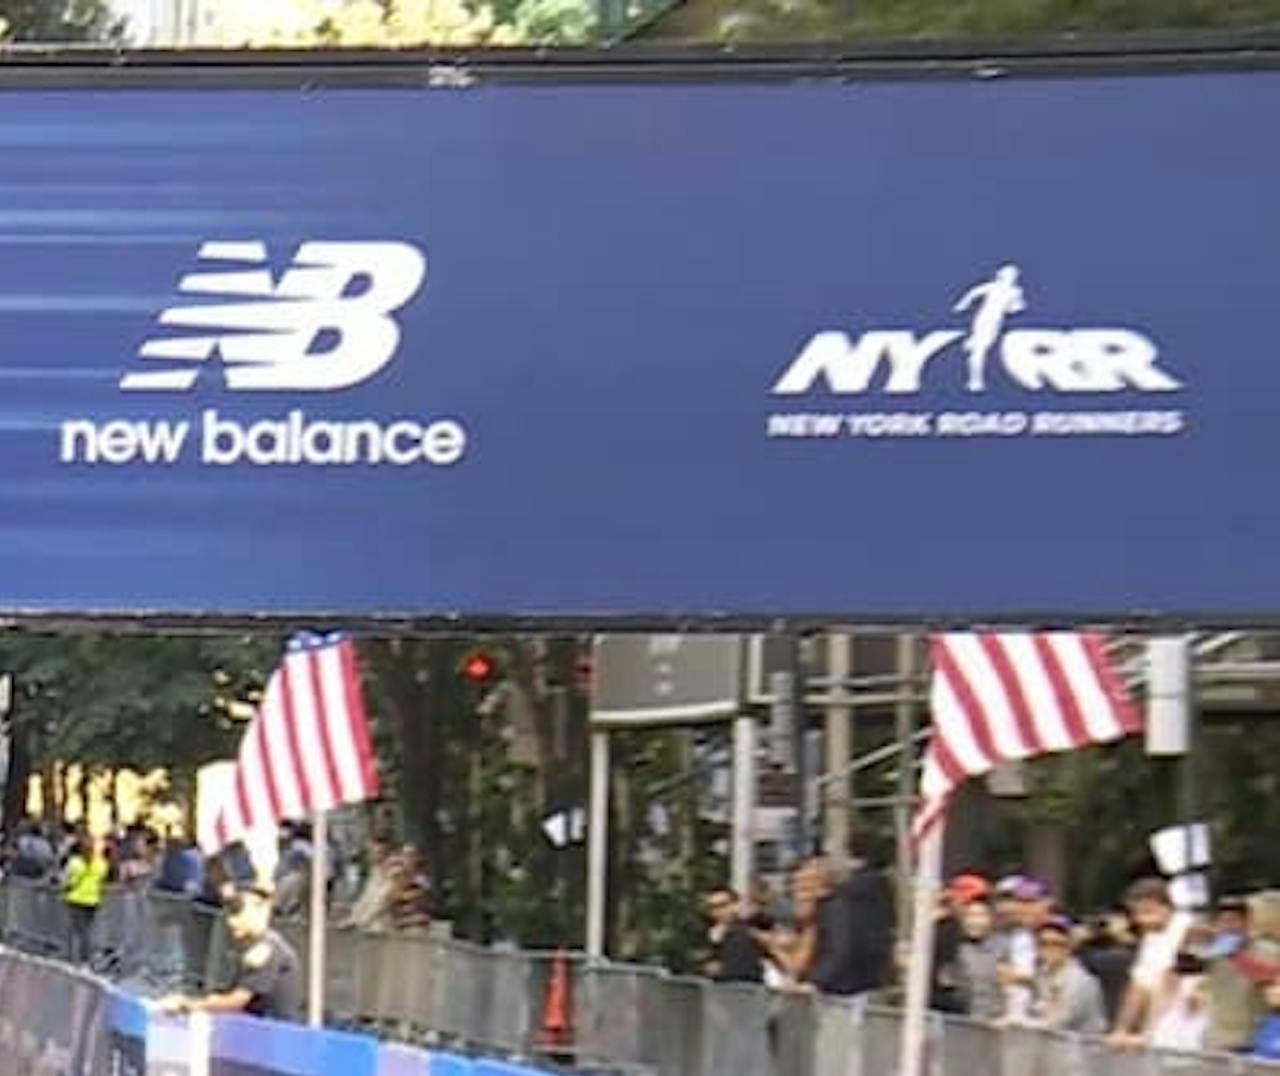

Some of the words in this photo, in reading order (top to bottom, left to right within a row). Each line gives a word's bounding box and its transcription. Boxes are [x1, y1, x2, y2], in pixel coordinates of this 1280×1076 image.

[119, 240, 426, 390] NB
[61, 419, 189, 462] new
[202, 409, 465, 464] balance
[767, 412, 843, 437] NEW
[846, 412, 932, 437] YORK
[936, 411, 1028, 436] ROAD
[1031, 410, 1183, 435] RUNNERS
